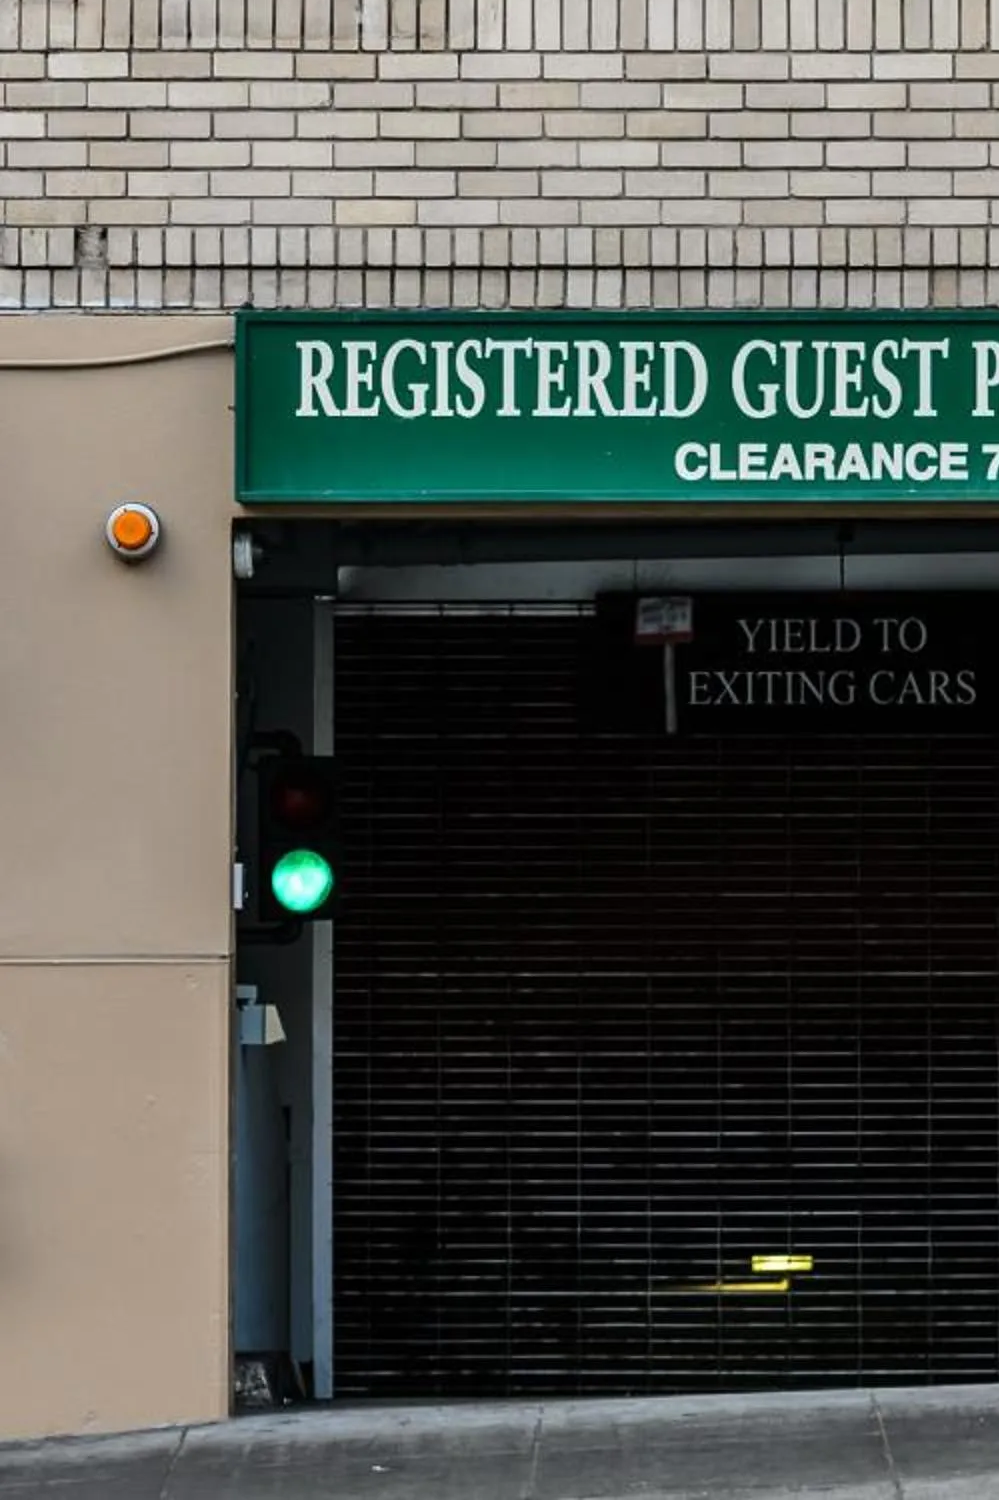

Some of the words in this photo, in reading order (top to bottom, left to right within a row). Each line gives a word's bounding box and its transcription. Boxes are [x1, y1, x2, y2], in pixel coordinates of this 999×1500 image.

[295, 338, 708, 419] REGISTERED
[731, 336, 949, 419] GUEST
[674, 443, 968, 481] CLEARANCE
[737, 618, 862, 653] YIELD
[873, 617, 928, 653] TO
[688, 670, 856, 705] EXITING
[869, 670, 977, 705] CARS
